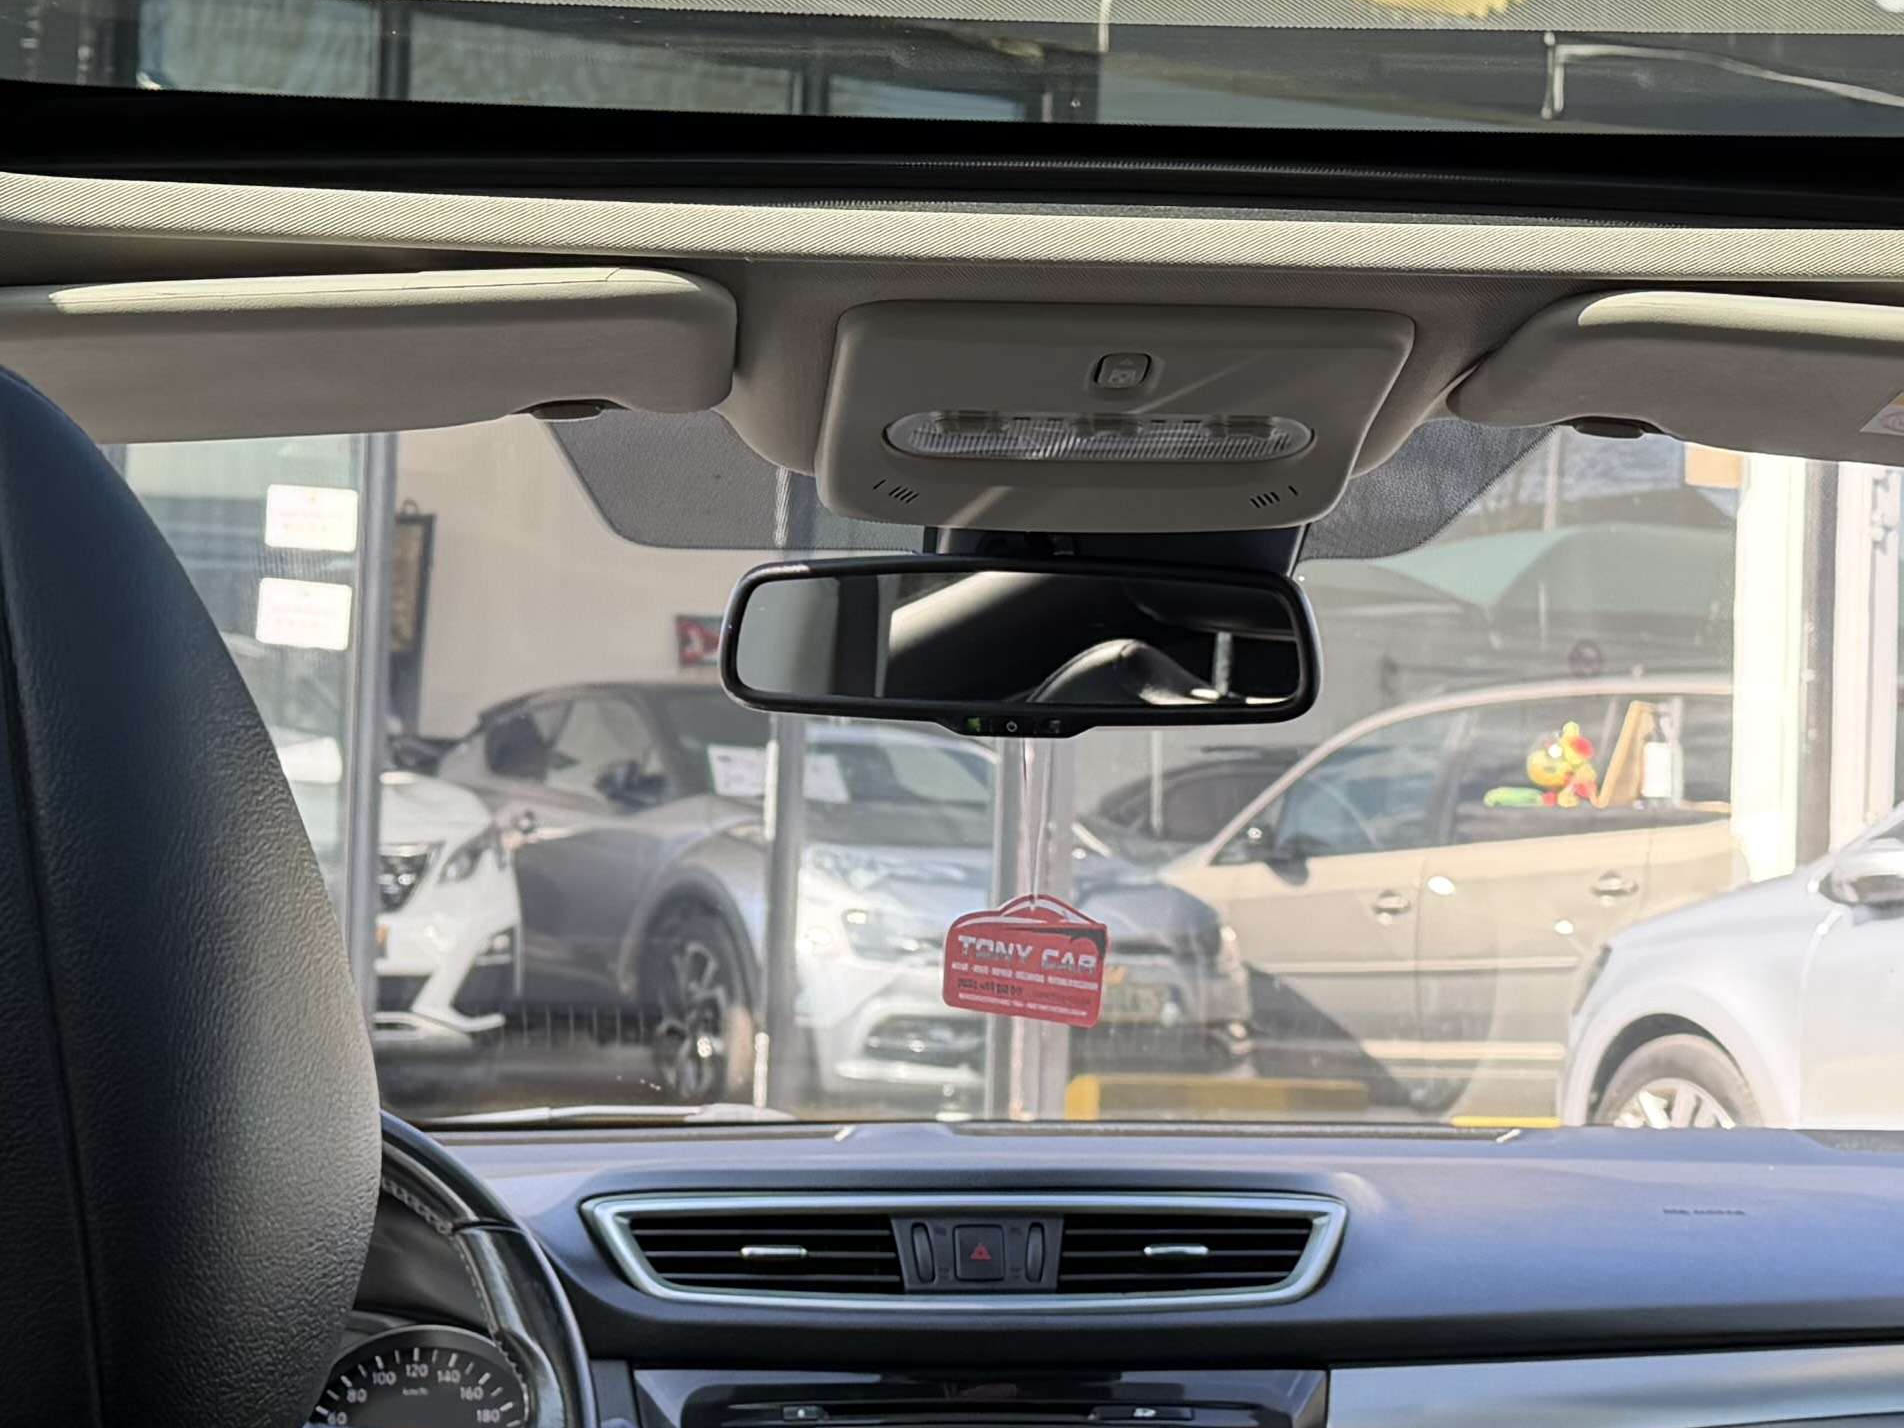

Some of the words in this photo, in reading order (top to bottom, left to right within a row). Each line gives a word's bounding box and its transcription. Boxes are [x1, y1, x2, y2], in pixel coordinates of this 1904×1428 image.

[958, 935, 1033, 964] TONY
[1042, 949, 1097, 974] CAR
[405, 1363, 428, 1377] 120
[437, 1369, 460, 1384] 140
[372, 1372, 396, 1385] 100
[347, 1389, 367, 1403] 80
[459, 1386, 483, 1401] 160
[476, 1409, 500, 1423] 180
